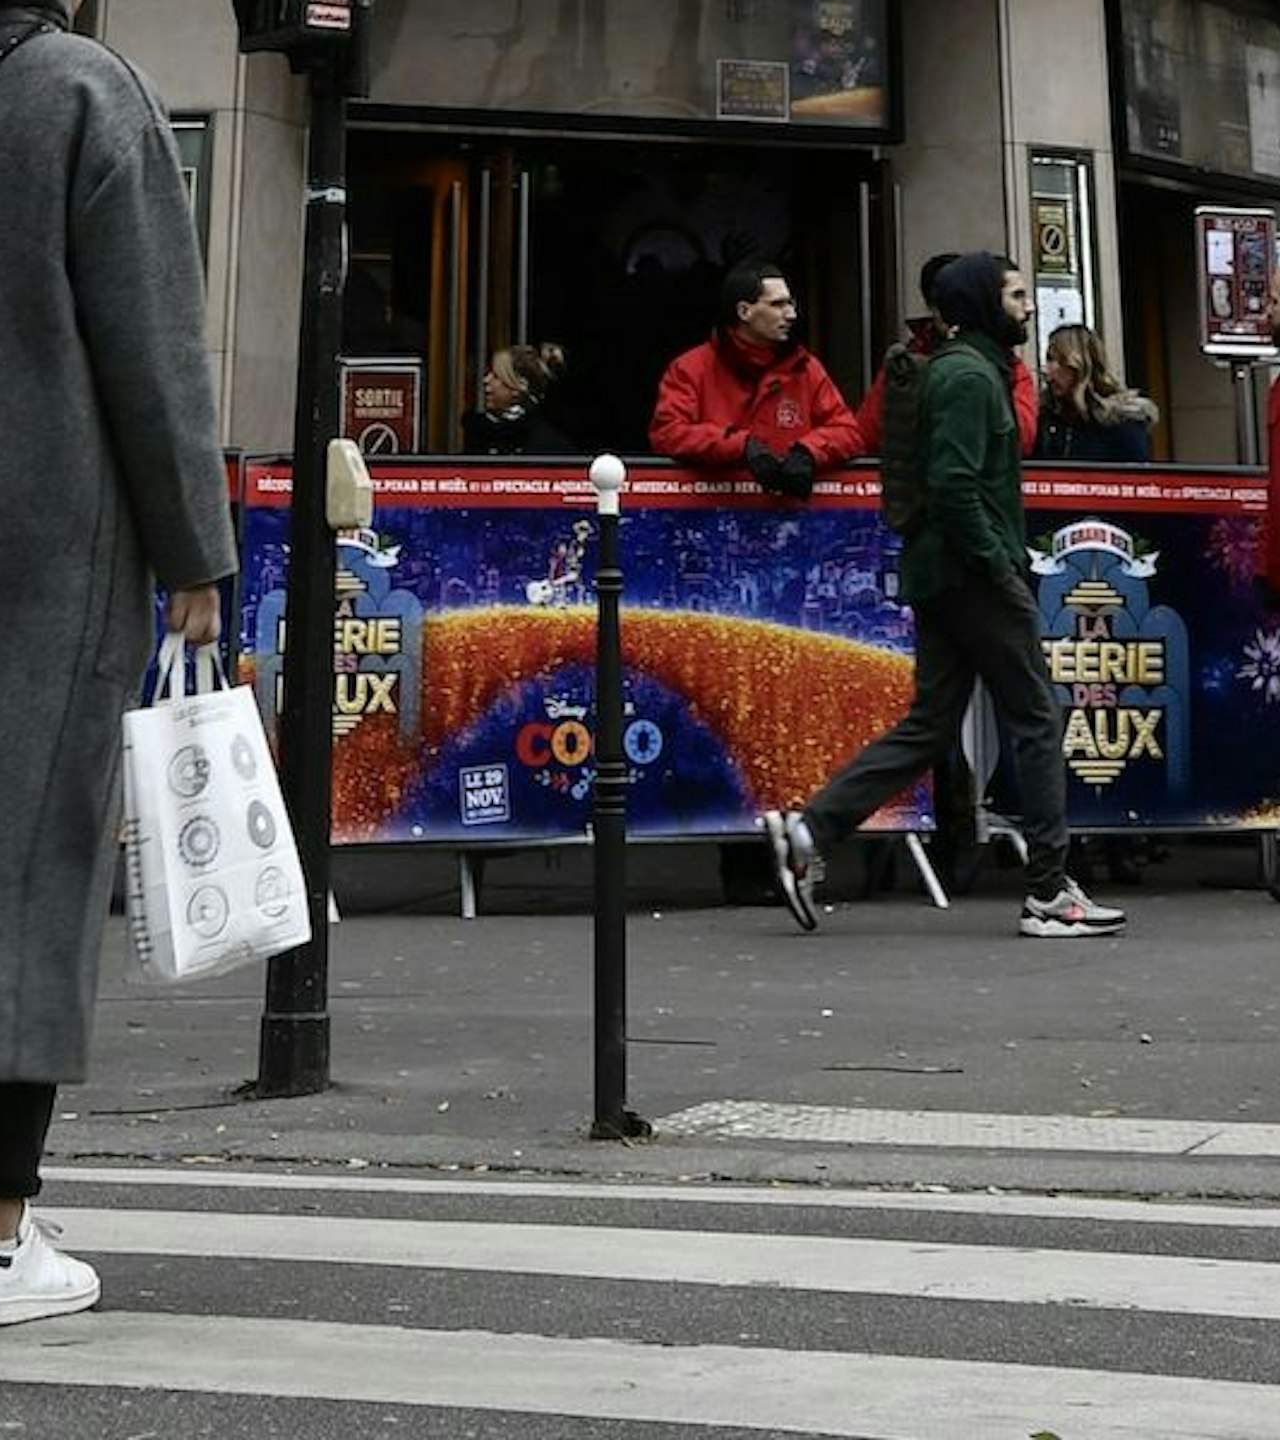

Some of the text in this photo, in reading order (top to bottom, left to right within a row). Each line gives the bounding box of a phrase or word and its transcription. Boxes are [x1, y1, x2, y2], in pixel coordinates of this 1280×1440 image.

[421, 480, 437, 492] DE
[438, 477, 468, 492] NOËL
[492, 480, 550, 494] SPECTACLE
[632, 481, 680, 494] MUSICAL
[1078, 615, 1111, 639] LA
[334, 654, 359, 673] ES
[1072, 683, 1117, 708] DES
[515, 720, 663, 768] COO
[1062, 708, 1163, 759] AUX
[464, 772, 483, 788] LE
